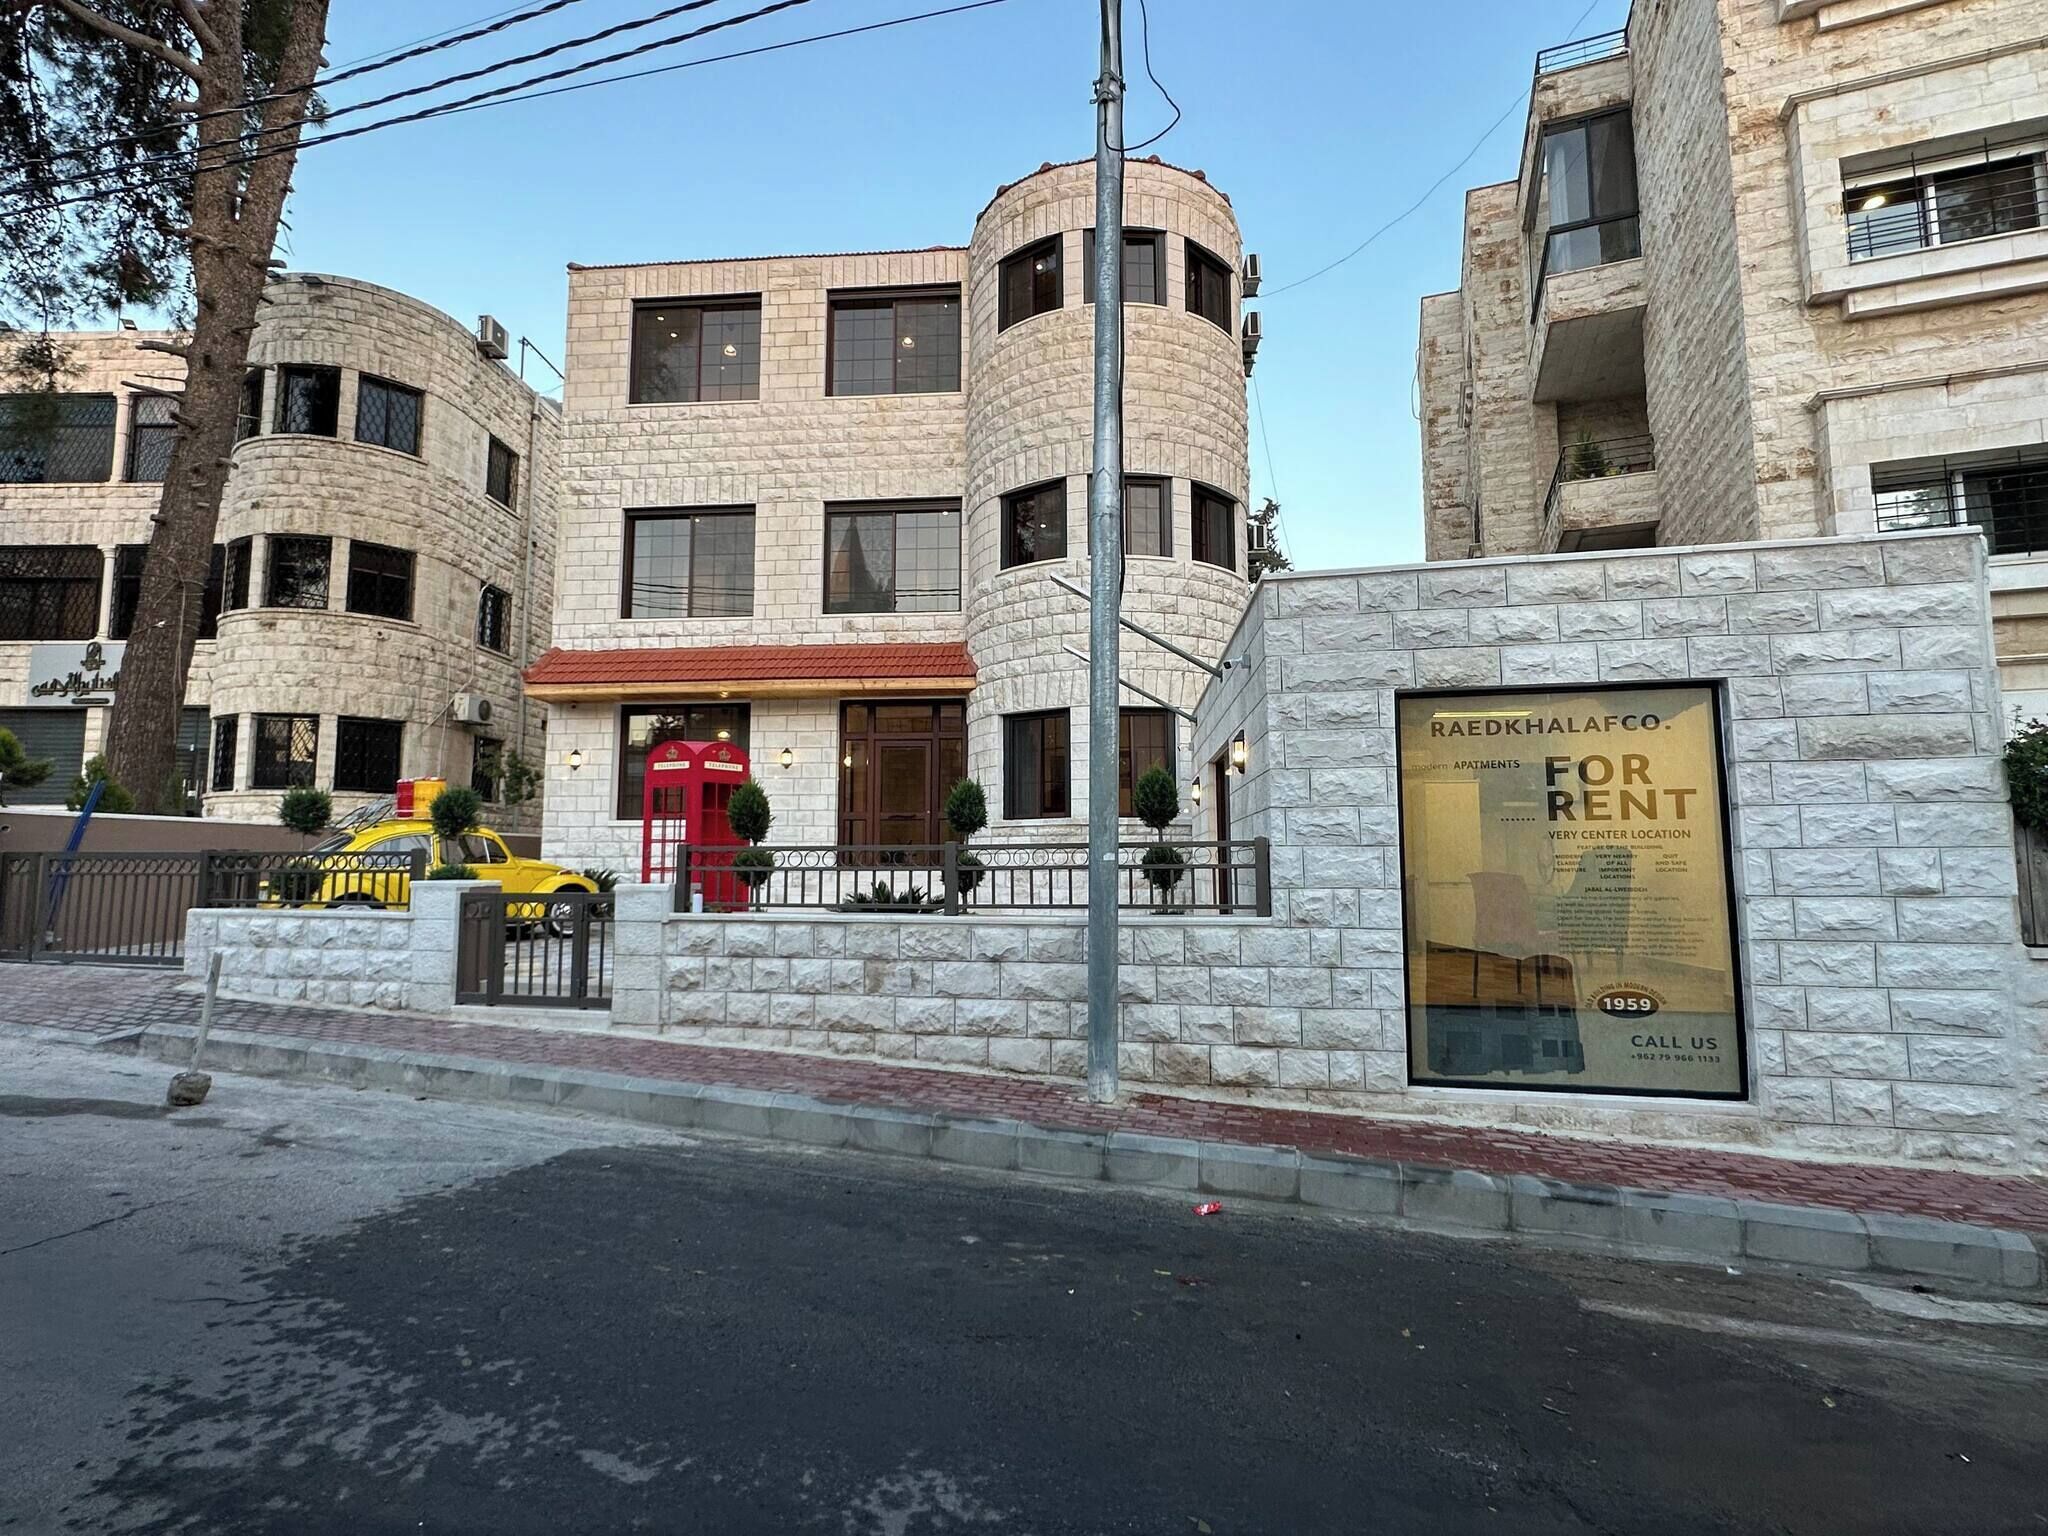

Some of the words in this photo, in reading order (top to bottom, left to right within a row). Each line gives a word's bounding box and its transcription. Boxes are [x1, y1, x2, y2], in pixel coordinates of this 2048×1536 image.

[1431, 713, 1672, 738] RAEDKHALAFCO.
[1411, 761, 1449, 772] modern
[1453, 759, 1521, 770] APATMENTS
[1546, 753, 1653, 787] FOR
[1547, 788, 1697, 822] RENT
[1549, 830, 1578, 840] VERY
[1581, 829, 1628, 840] CENTER
[1631, 829, 1692, 840] LOCATION
[1603, 997, 1652, 1011] 1959
[1631, 1035, 1682, 1050] CALL
[1691, 1037, 1718, 1051] US
[1631, 1053, 1656, 1062] +962
[1658, 1054, 1672, 1062] 79
